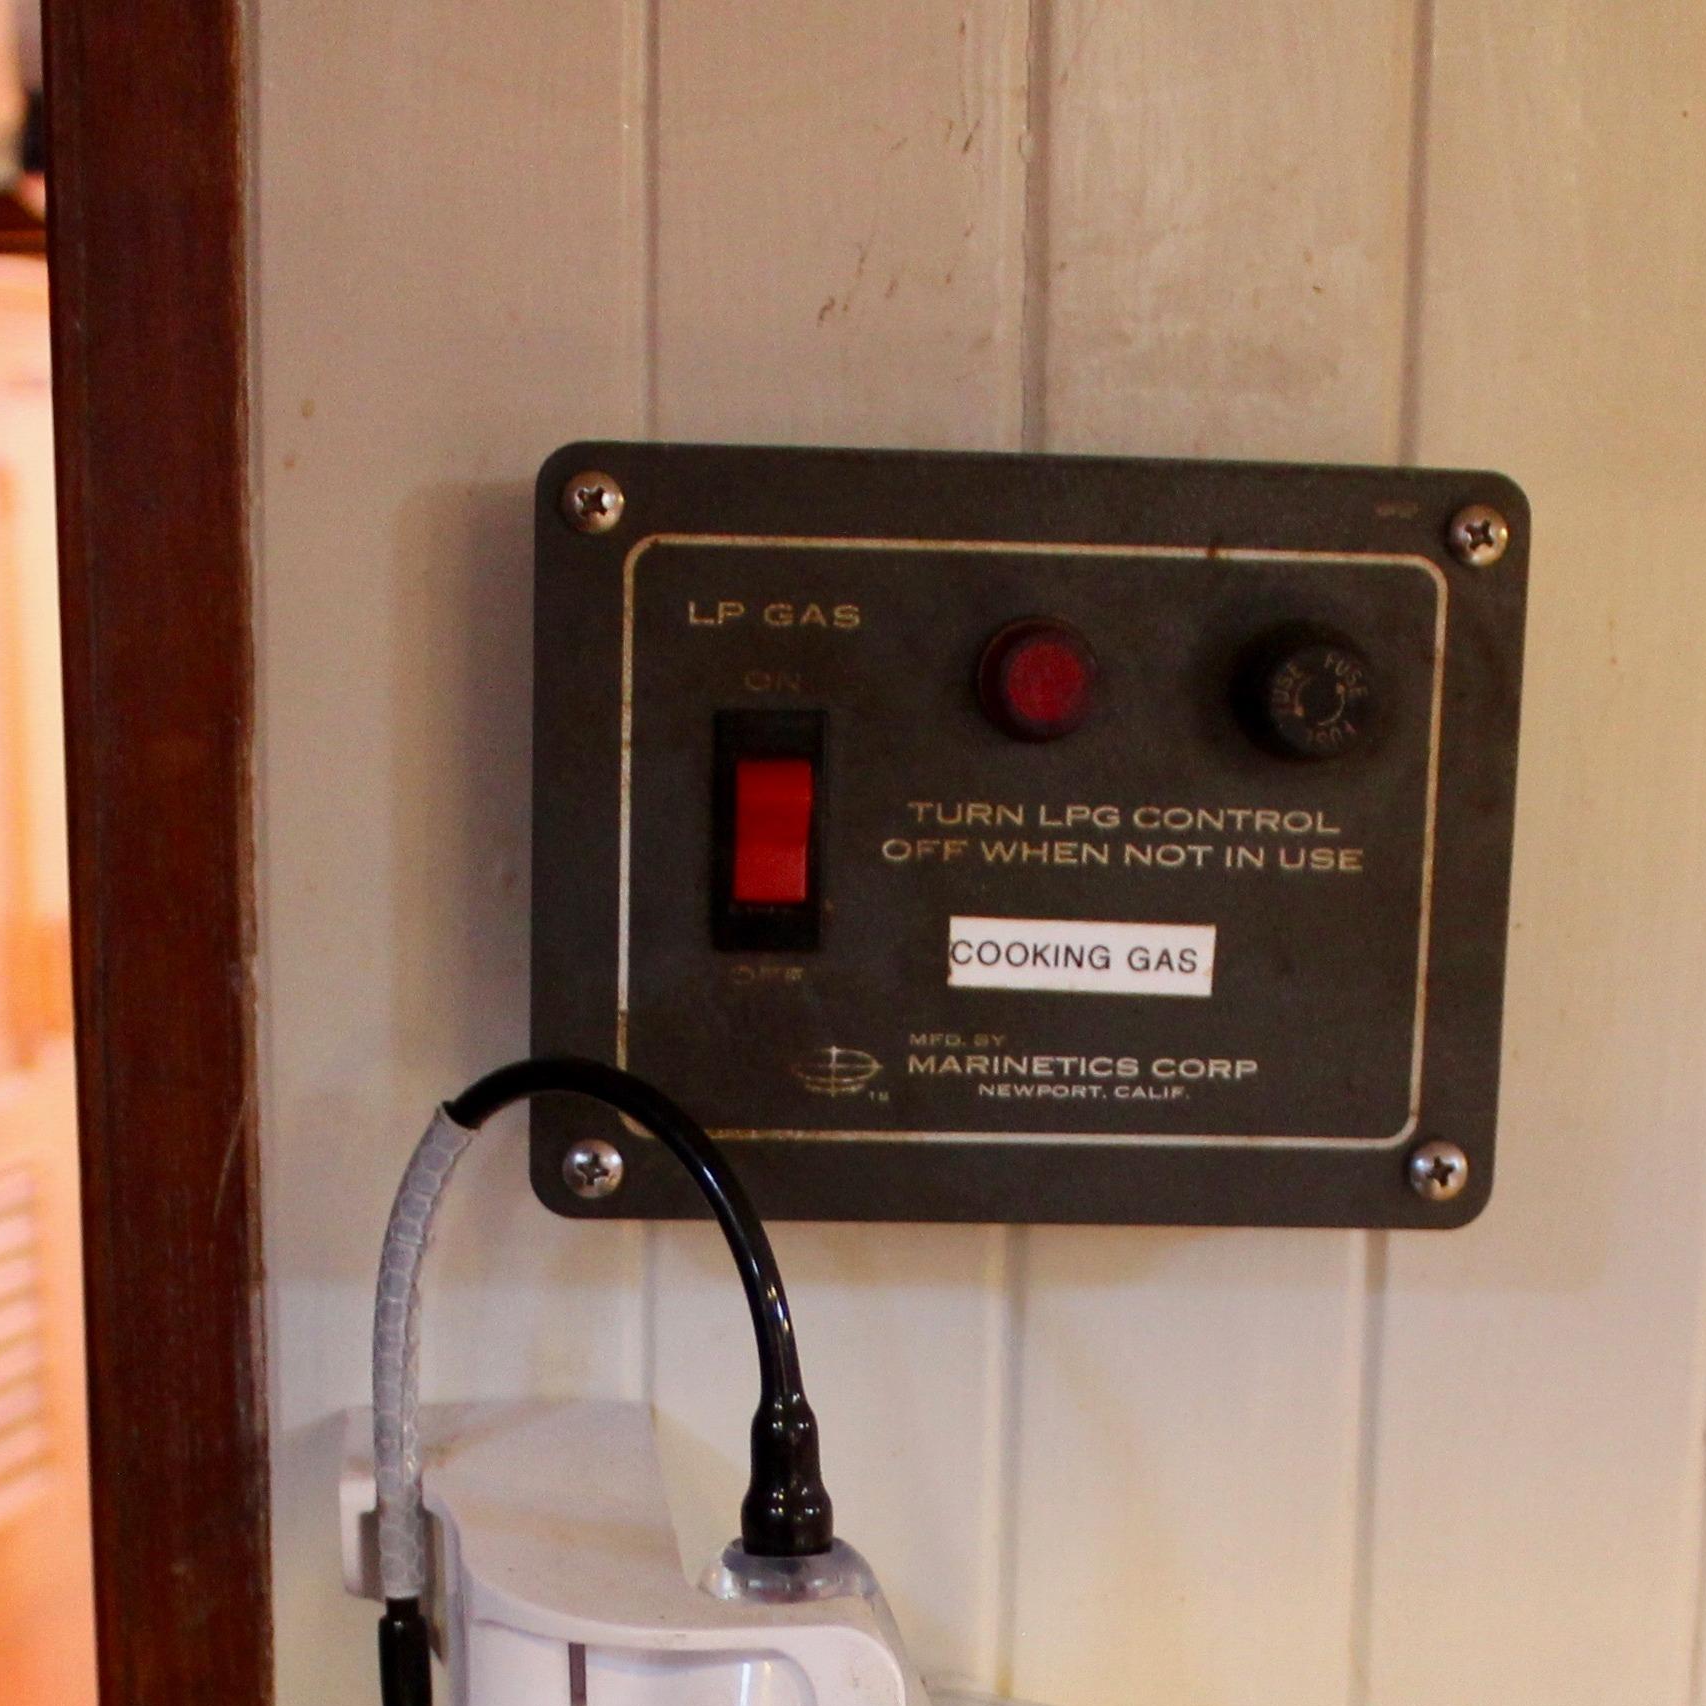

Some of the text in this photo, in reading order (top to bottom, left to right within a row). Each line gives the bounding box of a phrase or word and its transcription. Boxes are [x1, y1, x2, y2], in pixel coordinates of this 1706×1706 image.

[688, 601, 861, 628] LP GAS
[907, 801, 1342, 834] TURN LPG CONTROL
[881, 838, 1365, 871] OFF WHEN NOT IN USE
[950, 940, 1199, 975] COOKING GAS
[907, 1054, 1259, 1081] MARINETICS CORP
